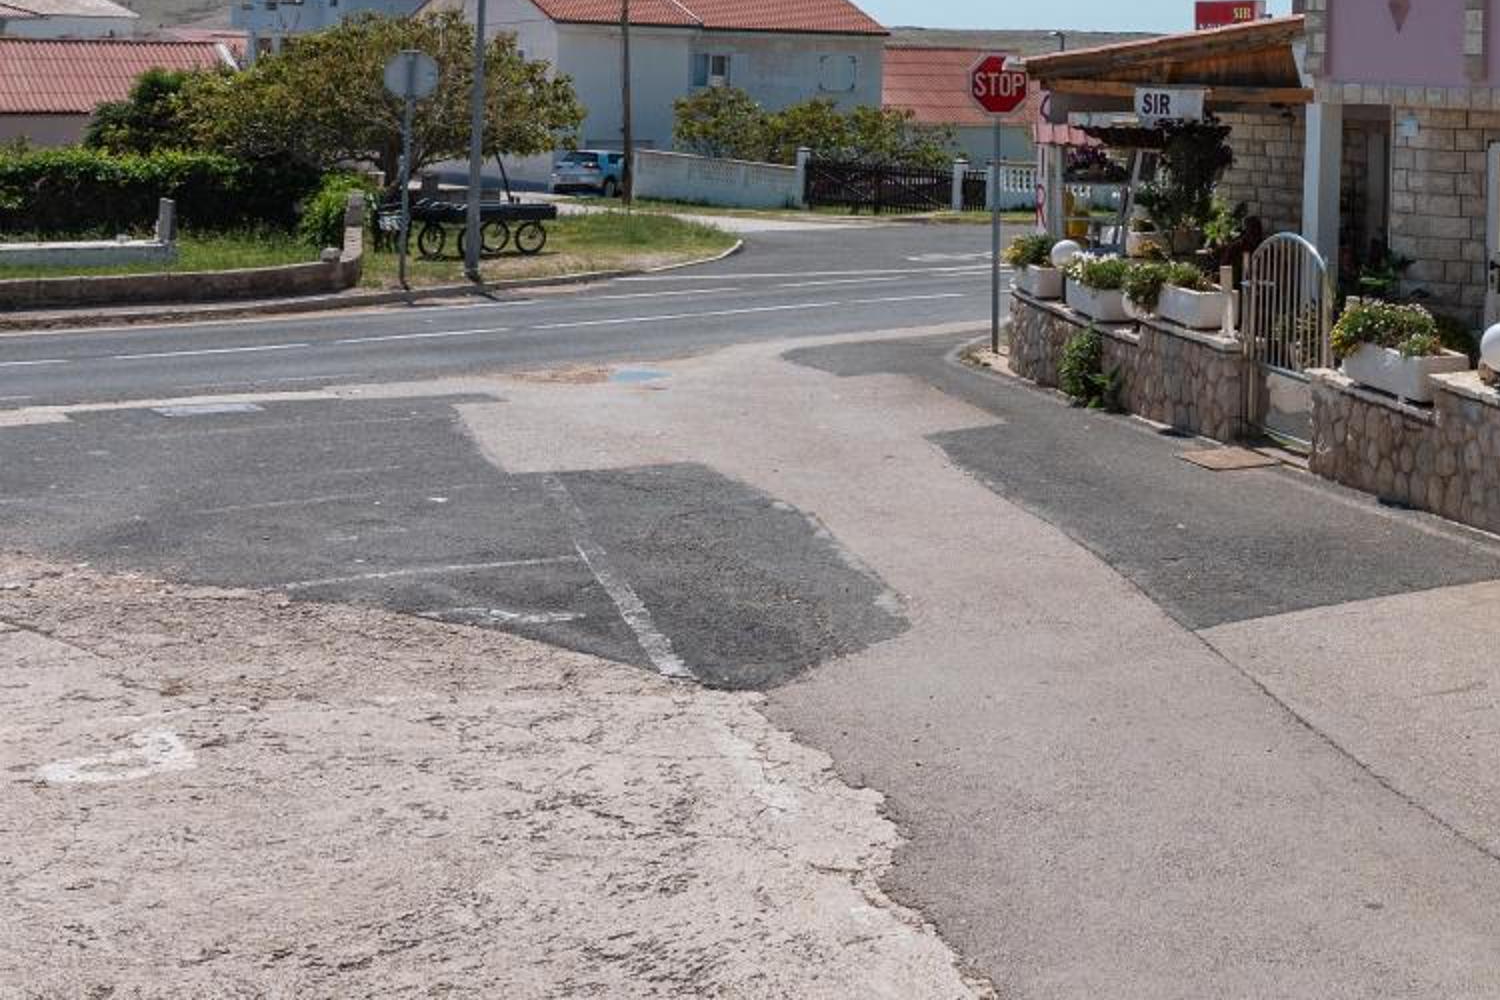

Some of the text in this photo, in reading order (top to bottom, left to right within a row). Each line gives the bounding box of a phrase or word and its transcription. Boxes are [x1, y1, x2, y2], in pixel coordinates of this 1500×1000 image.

[1233, 7, 1251, 19] SIR
[974, 72, 1025, 96] STOP
[1142, 93, 1171, 115] SIR
